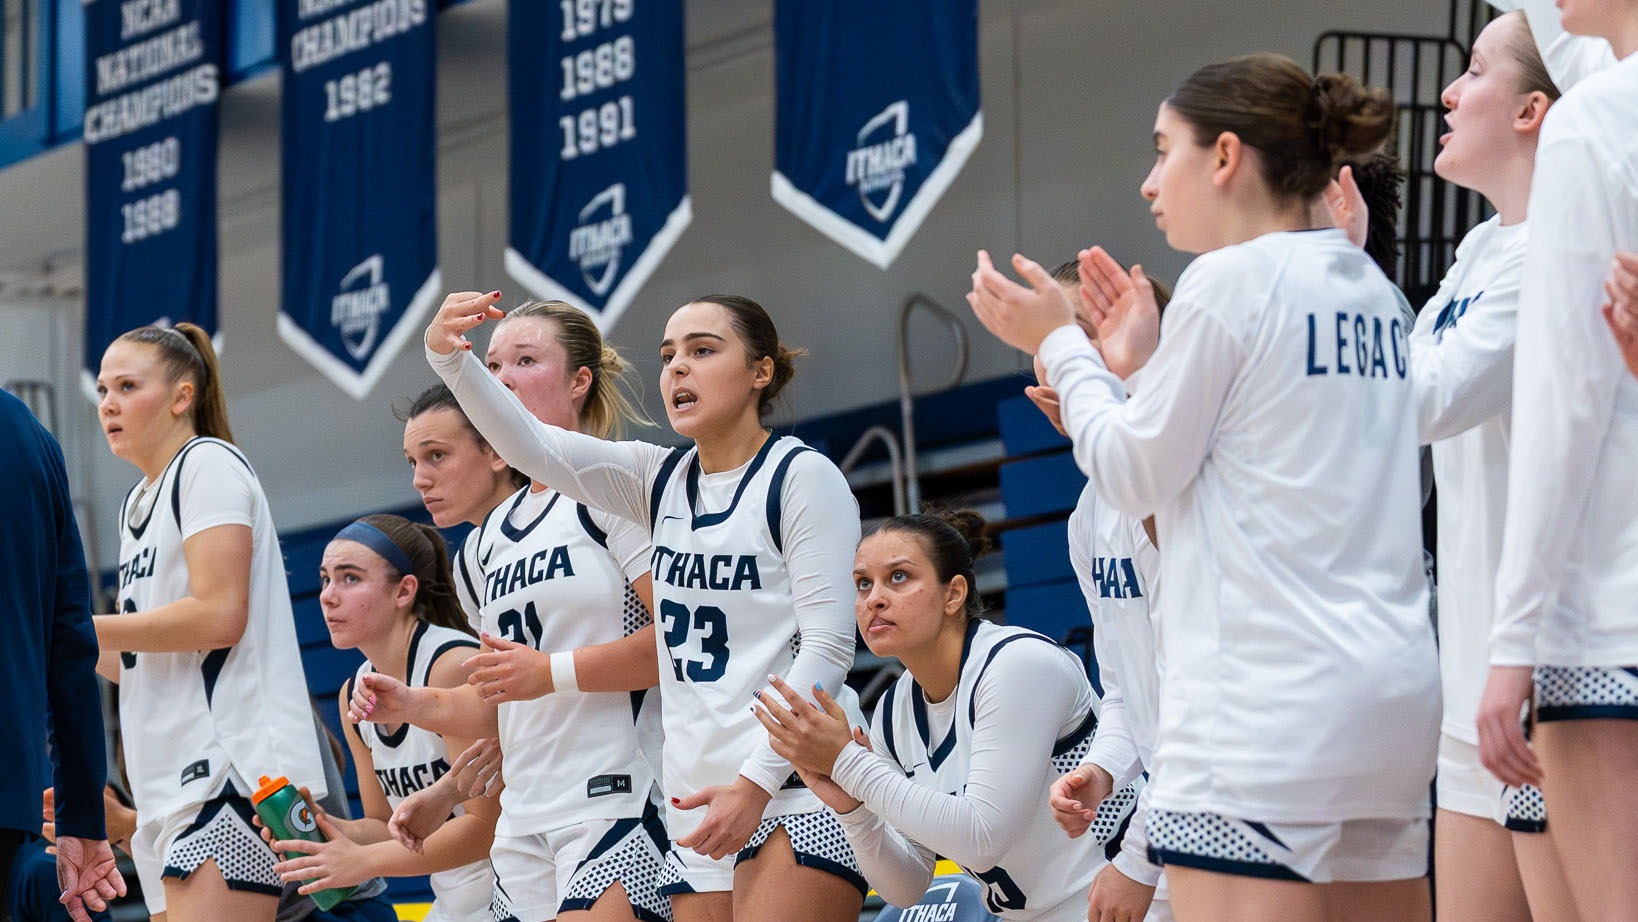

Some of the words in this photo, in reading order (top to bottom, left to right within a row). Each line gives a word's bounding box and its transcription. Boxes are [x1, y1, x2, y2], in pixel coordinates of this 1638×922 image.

[96, 20, 203, 95] NATIONAL
[560, 34, 635, 100] 1988
[83, 63, 219, 144] CHAMPIONS
[324, 61, 392, 122] 1982
[559, 95, 637, 161] 1991
[846, 133, 917, 184] ITHACA
[569, 213, 632, 261] ITHACA
[1306, 310, 1406, 380] LEGAC
[484, 544, 576, 608] THACA
[660, 598, 730, 683] 23
[374, 757, 452, 798] THACA
[617, 779, 626, 788] M
[898, 902, 959, 922] ITHACA
